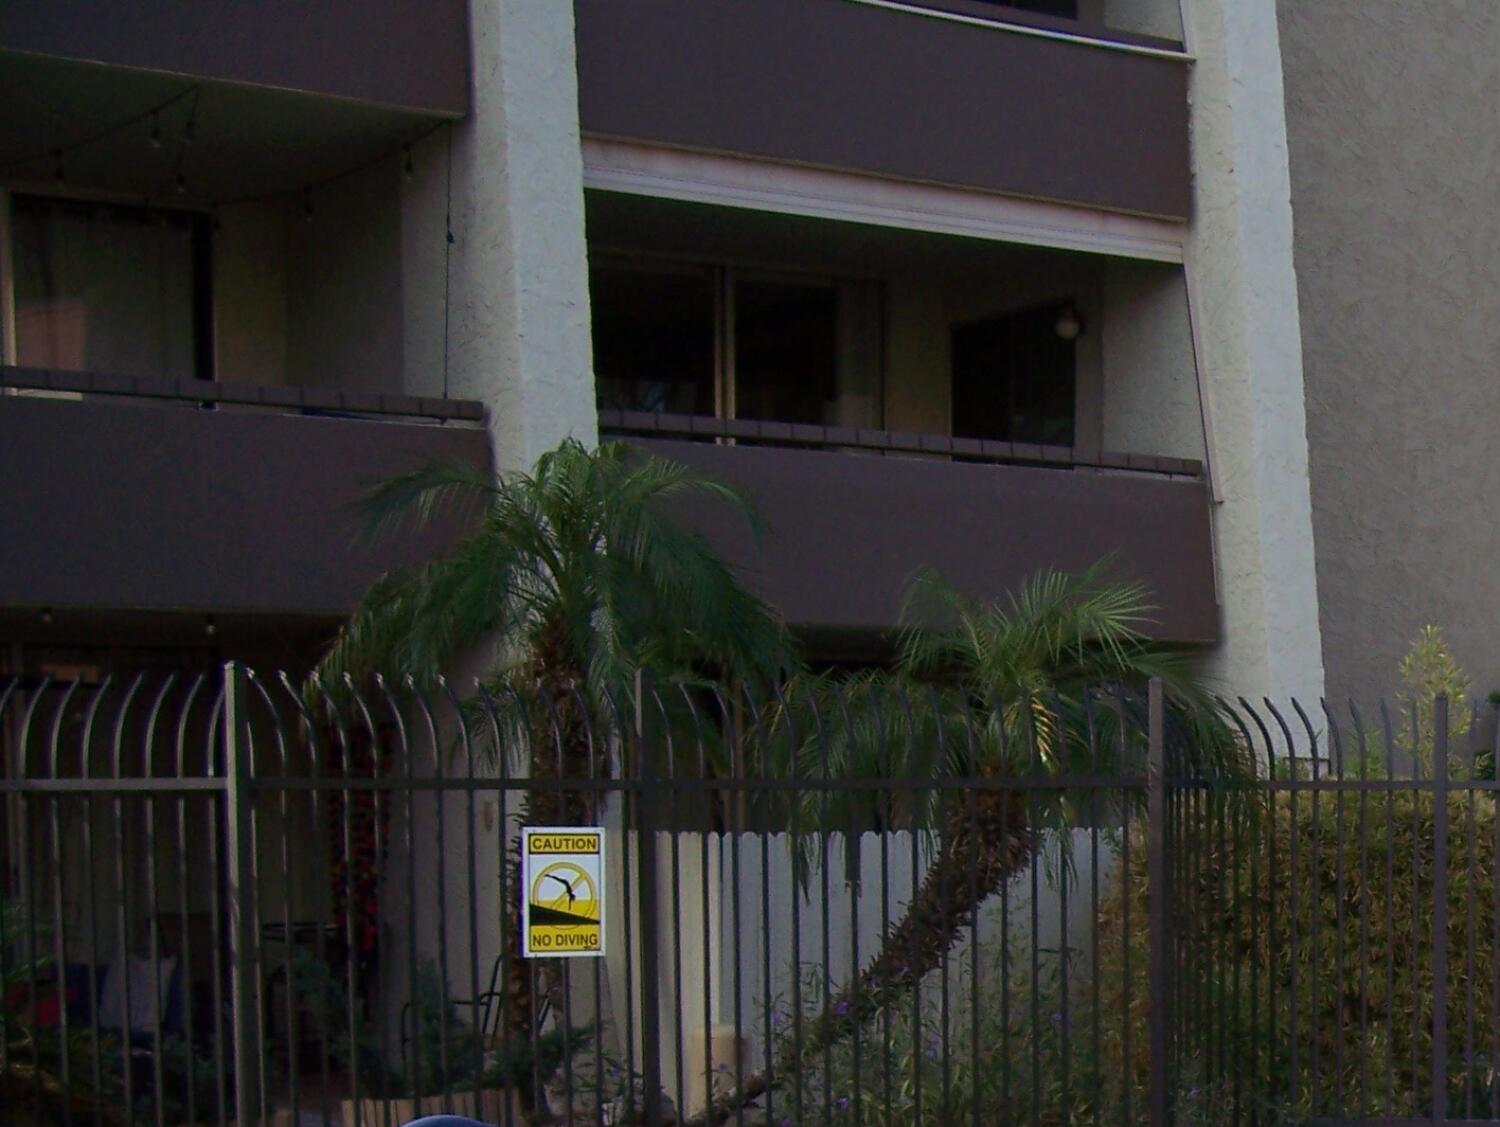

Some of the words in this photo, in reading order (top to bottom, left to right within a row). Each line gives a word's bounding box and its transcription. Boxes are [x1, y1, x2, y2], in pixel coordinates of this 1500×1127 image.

[532, 838, 596, 850] CAUTION
[533, 934, 551, 946] NO
[556, 934, 598, 946] DIVING
